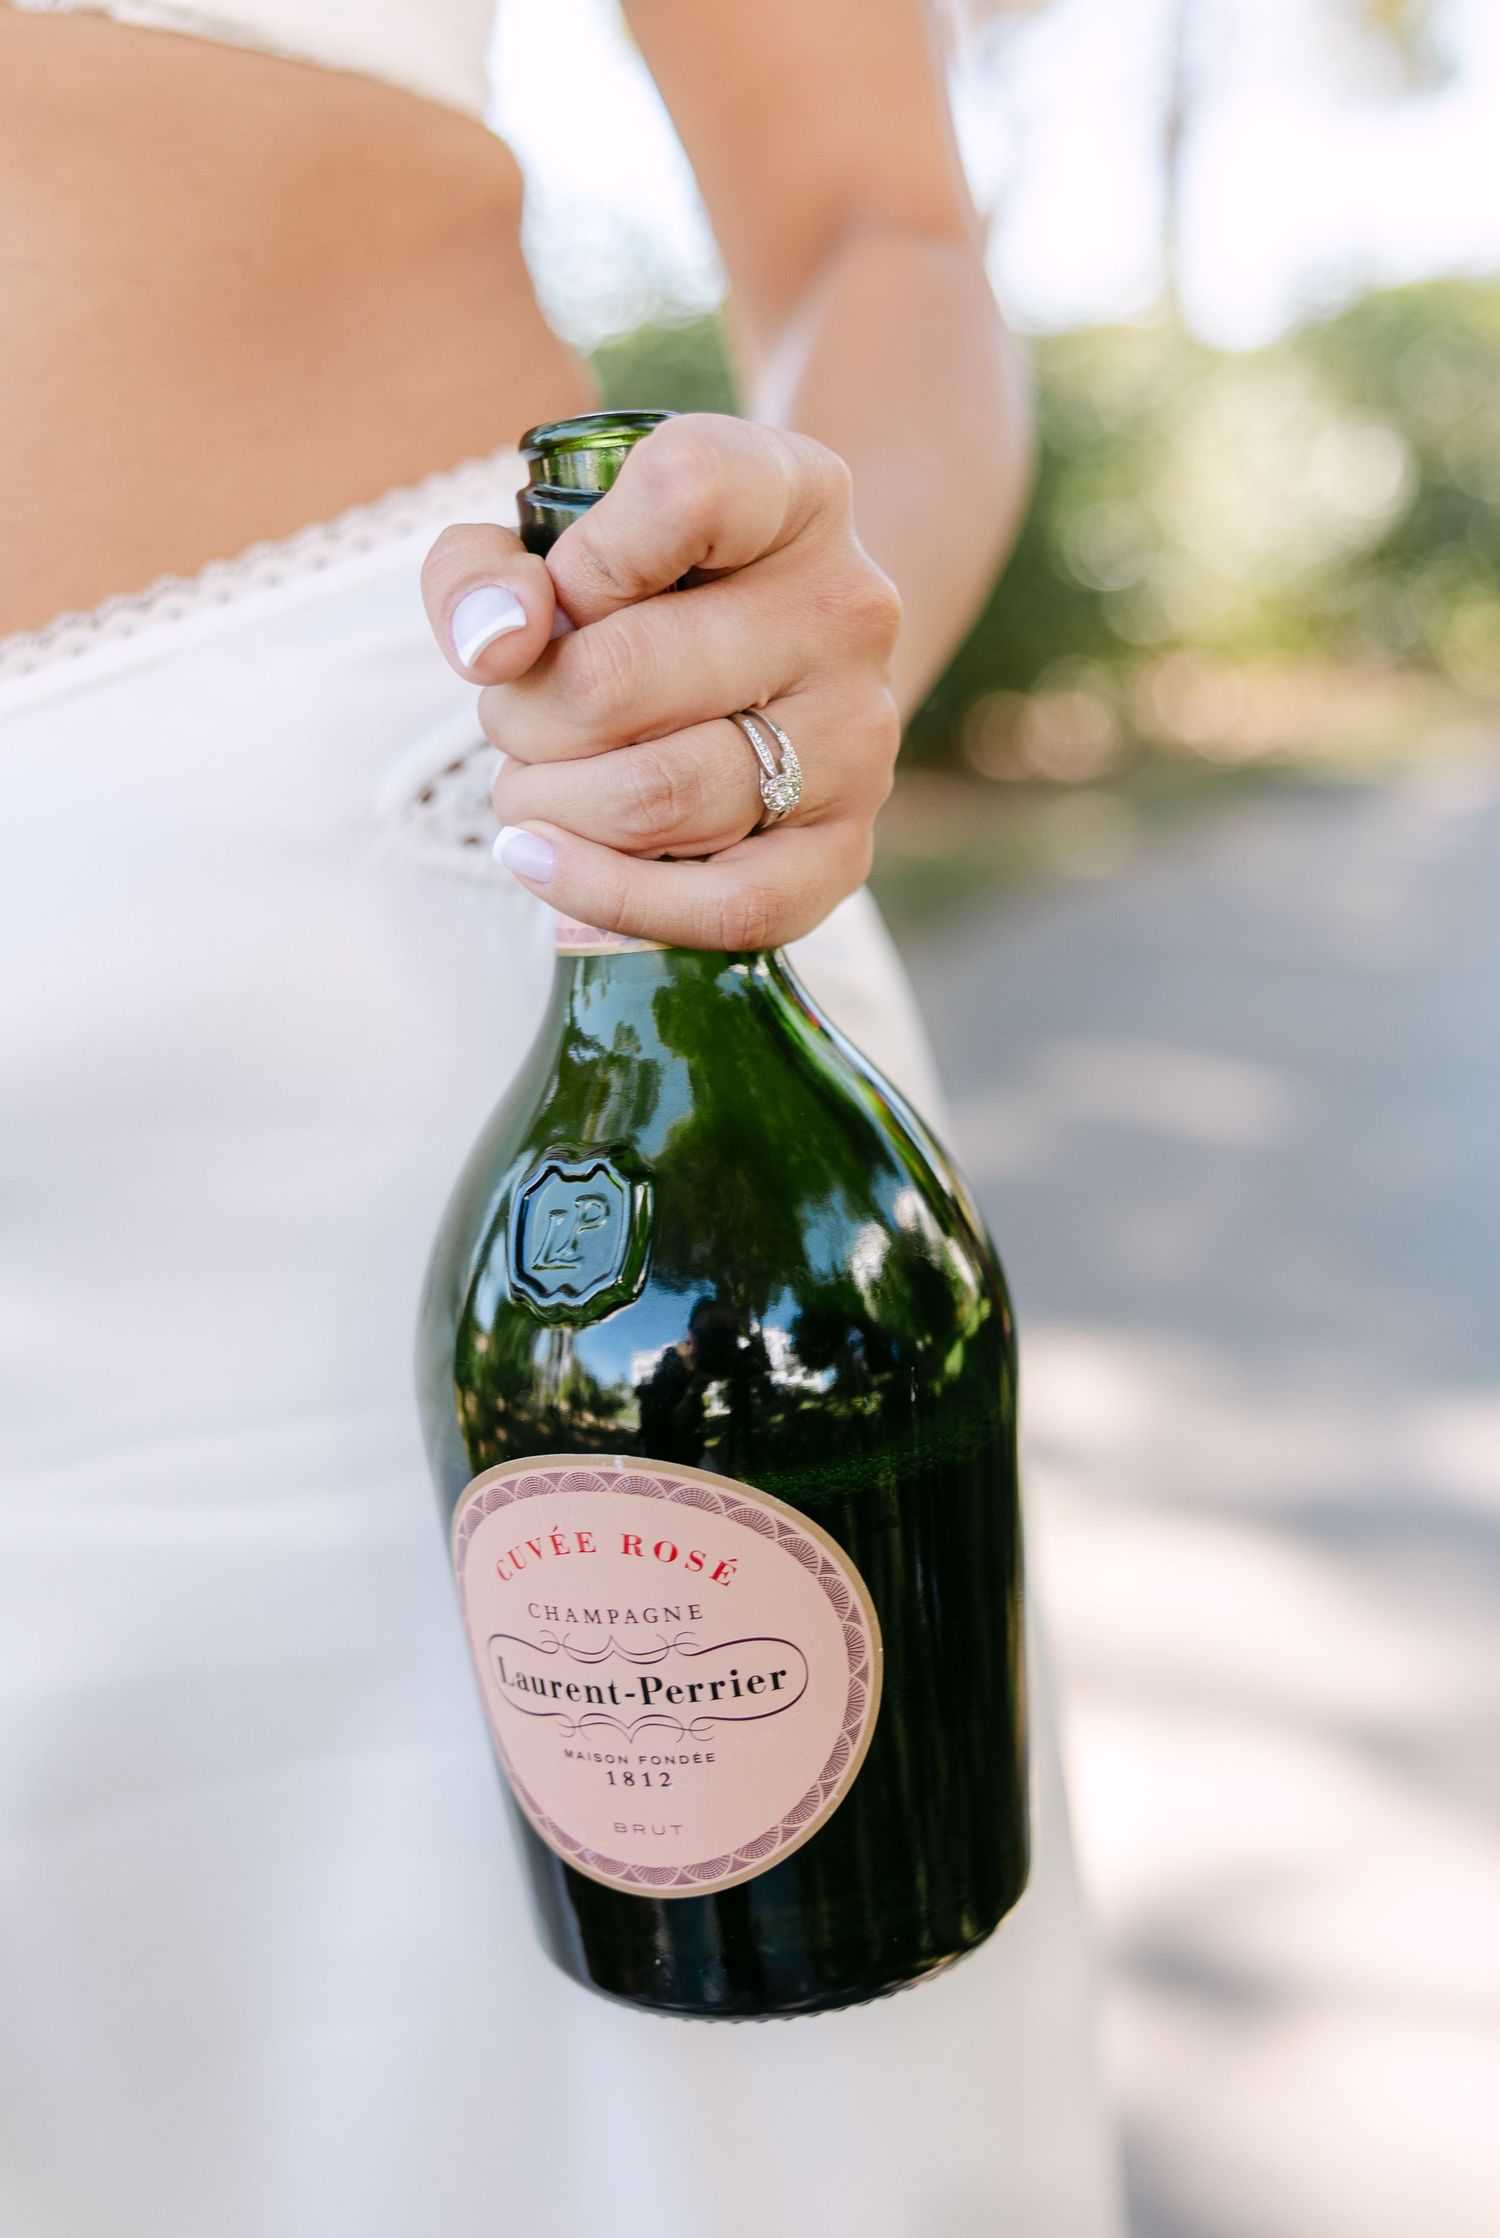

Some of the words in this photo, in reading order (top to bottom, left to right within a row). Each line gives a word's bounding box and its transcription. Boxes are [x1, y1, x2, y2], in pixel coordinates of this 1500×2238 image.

[496, 1526, 597, 1582] CUVÉE
[620, 1533, 739, 1588] ROSÉ
[527, 1603, 703, 1625] CHAMPAGNE
[497, 1656, 787, 1706] Laurent-Perrier
[564, 1748, 629, 1765] MAISON
[639, 1751, 717, 1766] FONDÉE
[606, 1770, 673, 1787] 1812
[613, 1822, 684, 1836] BRUT
